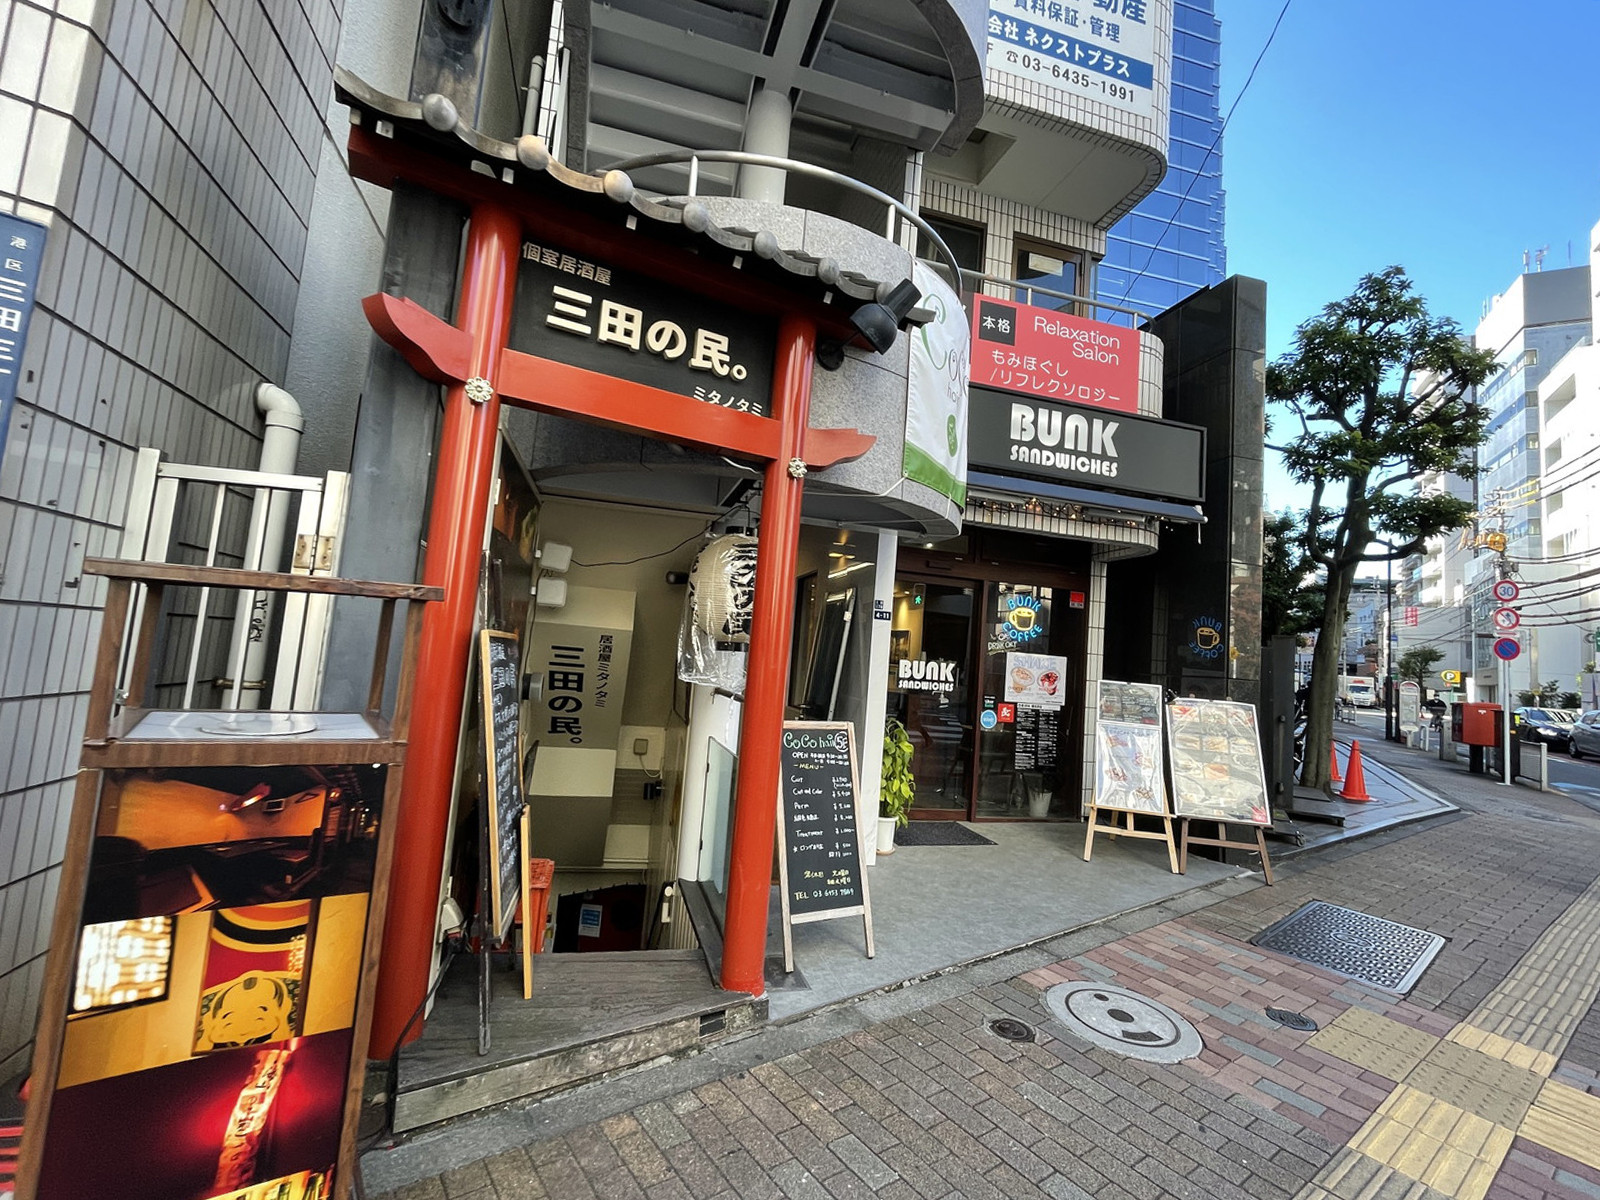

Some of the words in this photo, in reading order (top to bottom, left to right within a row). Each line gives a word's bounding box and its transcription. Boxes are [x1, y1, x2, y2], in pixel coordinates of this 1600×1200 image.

[1024, 26, 1130, 78] ネクストプラス
[1022, 54, 1134, 103] 03-6435-1991
[522, 241, 612, 286] 個室居酒屋
[545, 285, 748, 382] 三田の民。
[981, 314, 1011, 334] 本格
[1033, 315, 1121, 350] Relaxation
[991, 349, 1069, 378] もみほぐし
[1071, 341, 1120, 366] Salon
[693, 385, 763, 417] ミタノタミ
[1009, 402, 1120, 459] BUNK
[1009, 444, 1119, 478] SANDWICHES
[1007, 595, 1042, 612] BUNK
[1499, 586, 1514, 597] 30
[875, 611, 890, 619] 4-11
[1002, 621, 1043, 642] COFFEE
[898, 659, 957, 683] BUNK
[898, 679, 954, 692] SANDWICHES
[548, 644, 585, 744] 三田の民。
[794, 891, 809, 900] TEL
